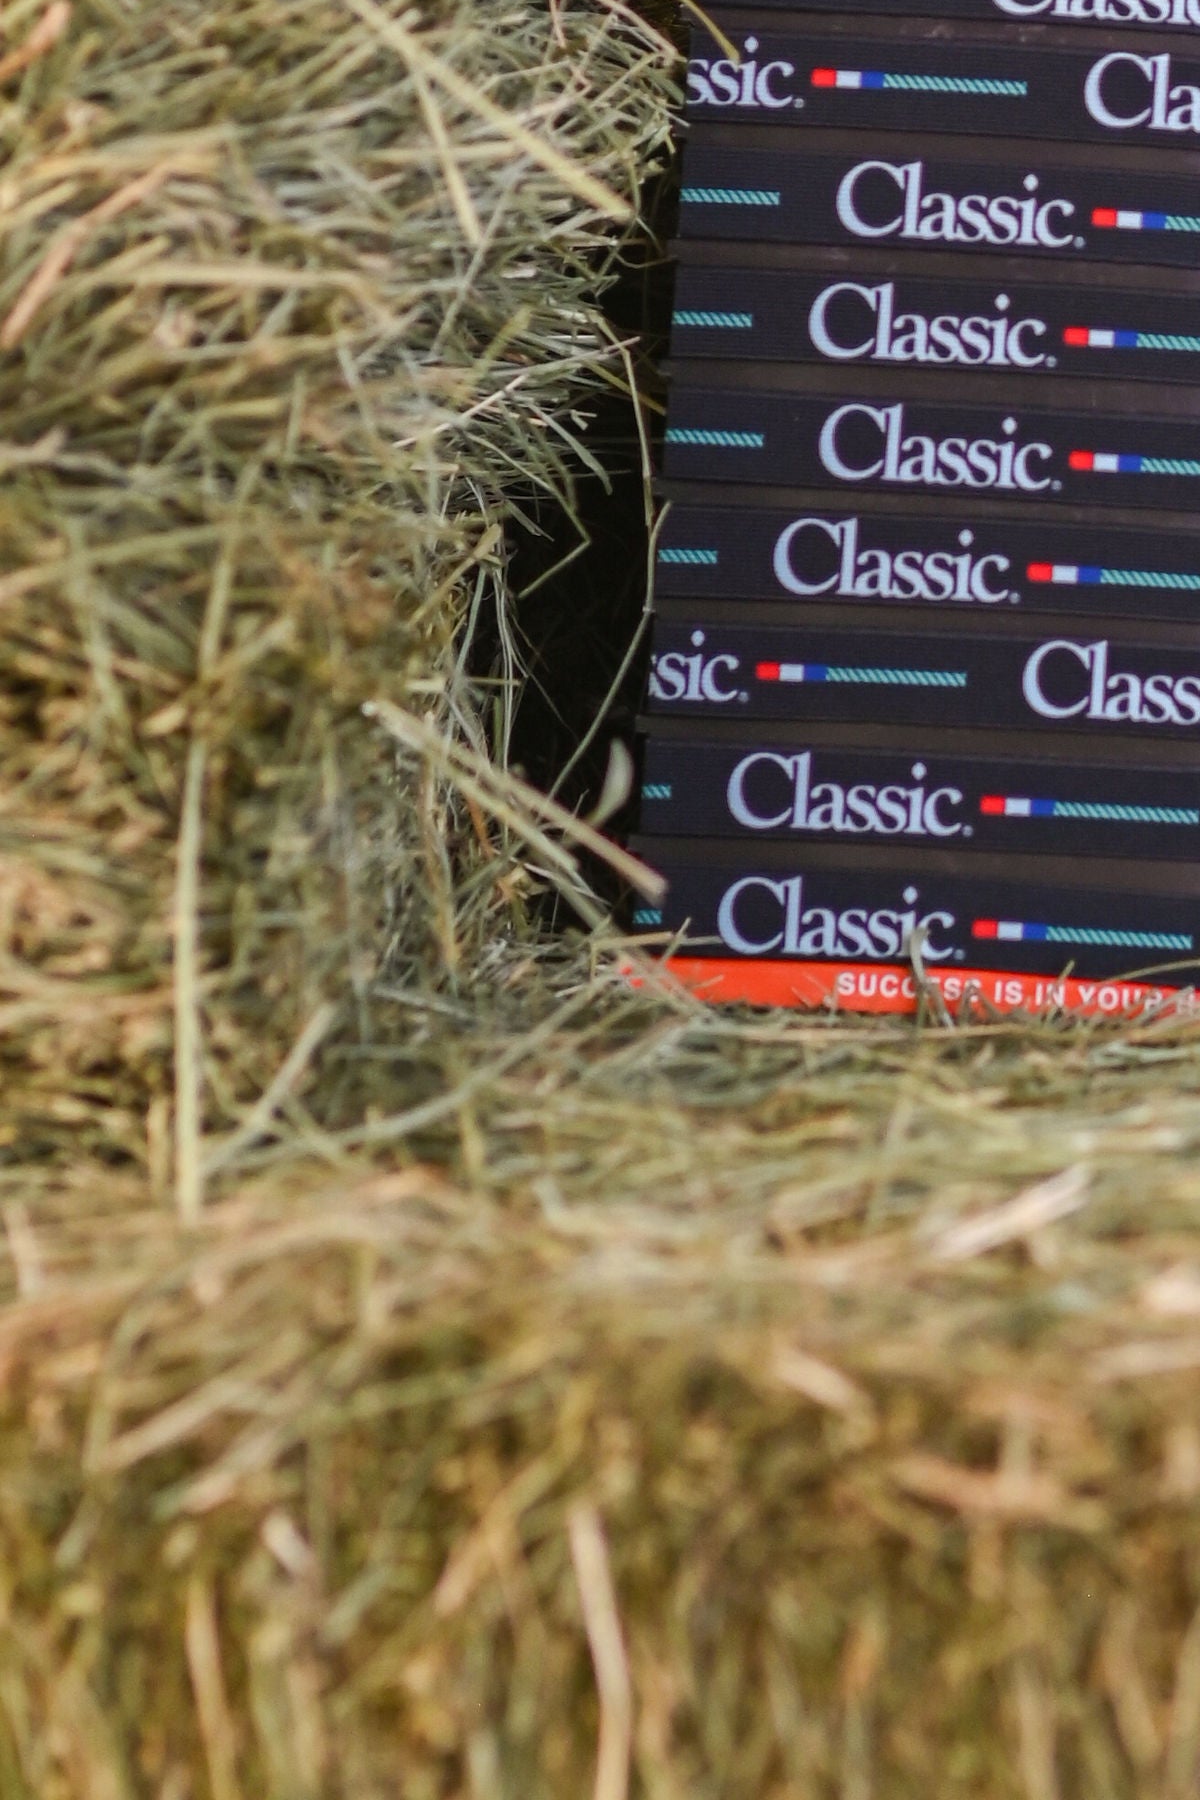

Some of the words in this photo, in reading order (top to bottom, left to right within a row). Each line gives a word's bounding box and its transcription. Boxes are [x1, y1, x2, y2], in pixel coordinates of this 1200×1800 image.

[836, 160, 1075, 248] Classic
[809, 282, 1047, 367] Classic
[819, 403, 1053, 491] Classic
[773, 517, 1010, 603] Classic
[728, 751, 963, 836] Classic
[717, 876, 955, 961] Classic
[993, 979, 1023, 1006] IS
[1035, 982, 1065, 1007] IN
